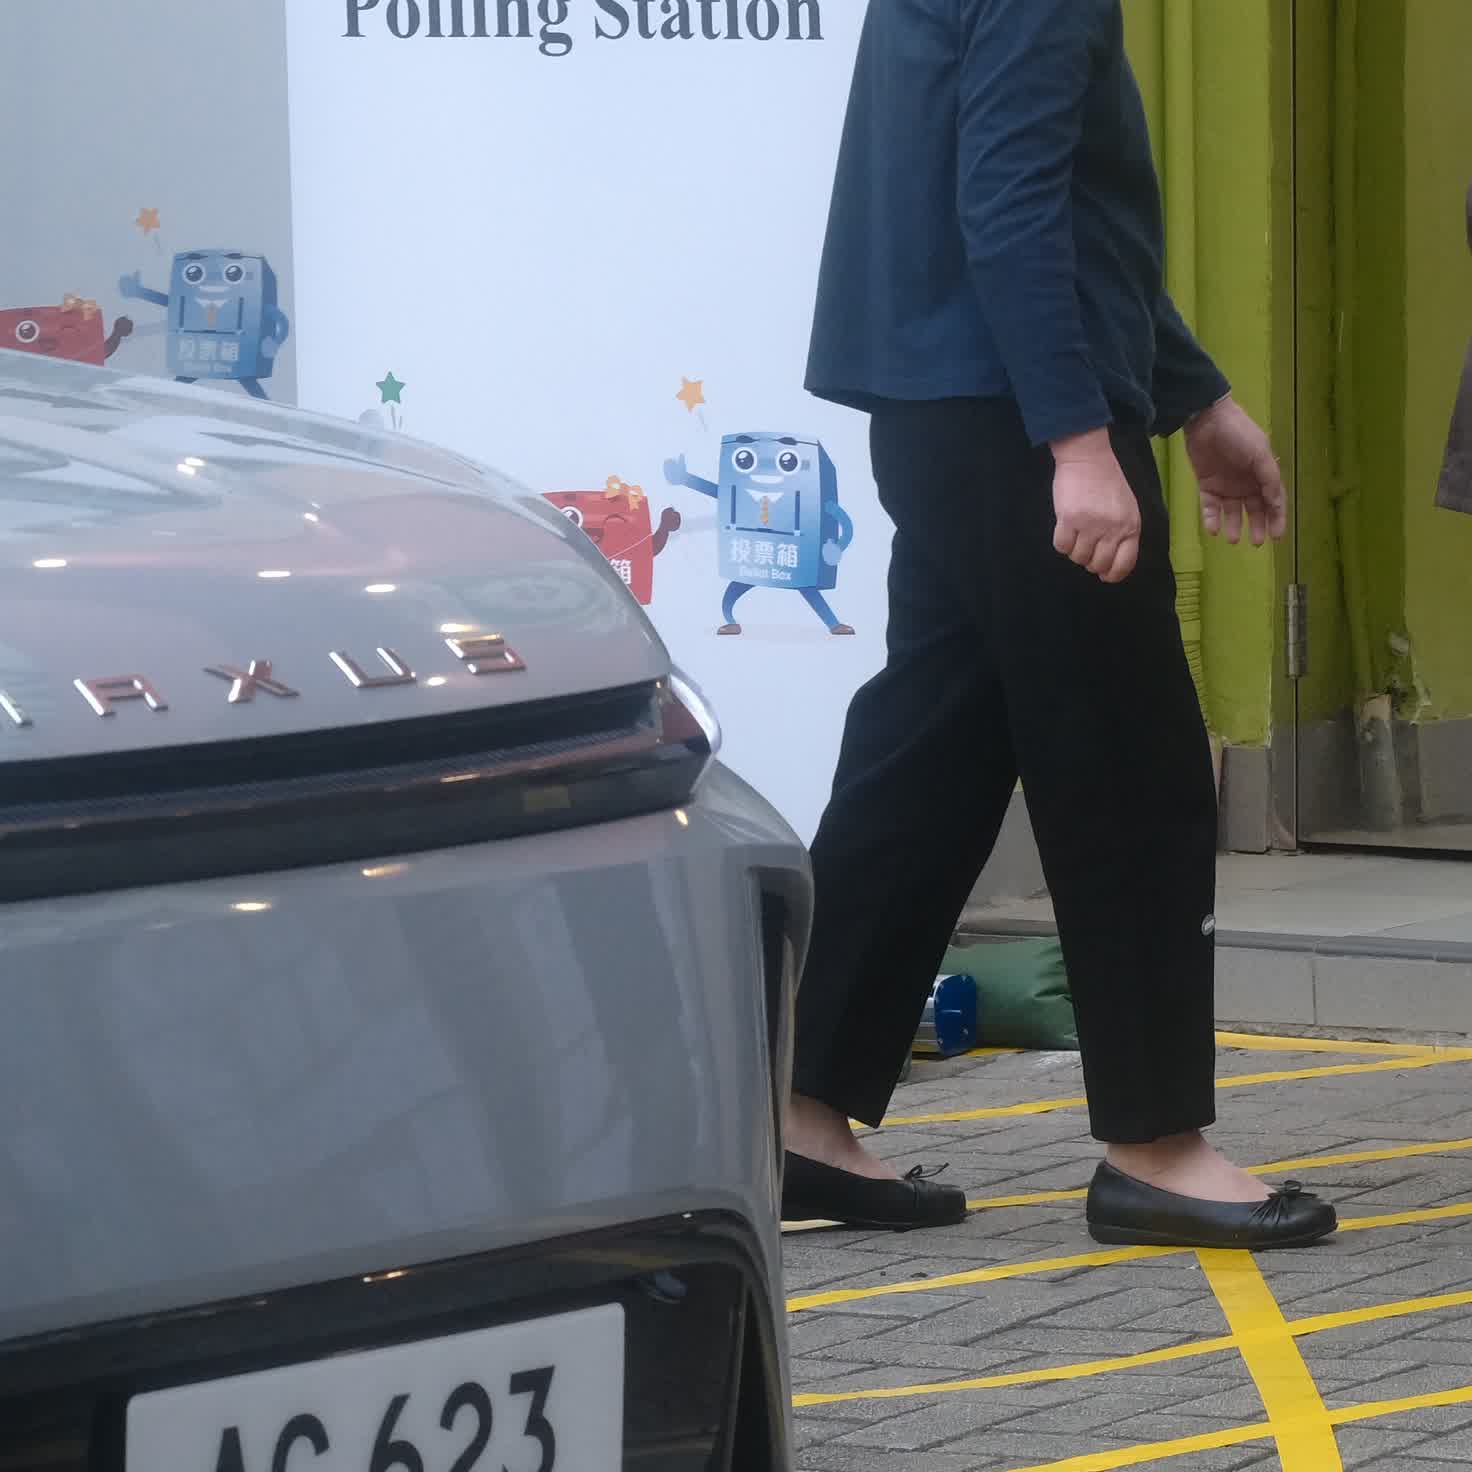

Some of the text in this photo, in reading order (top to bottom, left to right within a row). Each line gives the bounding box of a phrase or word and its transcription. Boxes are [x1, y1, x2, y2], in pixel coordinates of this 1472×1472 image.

[730, 538, 800, 568] 投票箱
[771, 568, 793, 581] Box
[0, 624, 527, 728] AXUS
[367, 1365, 557, 1472] 623
